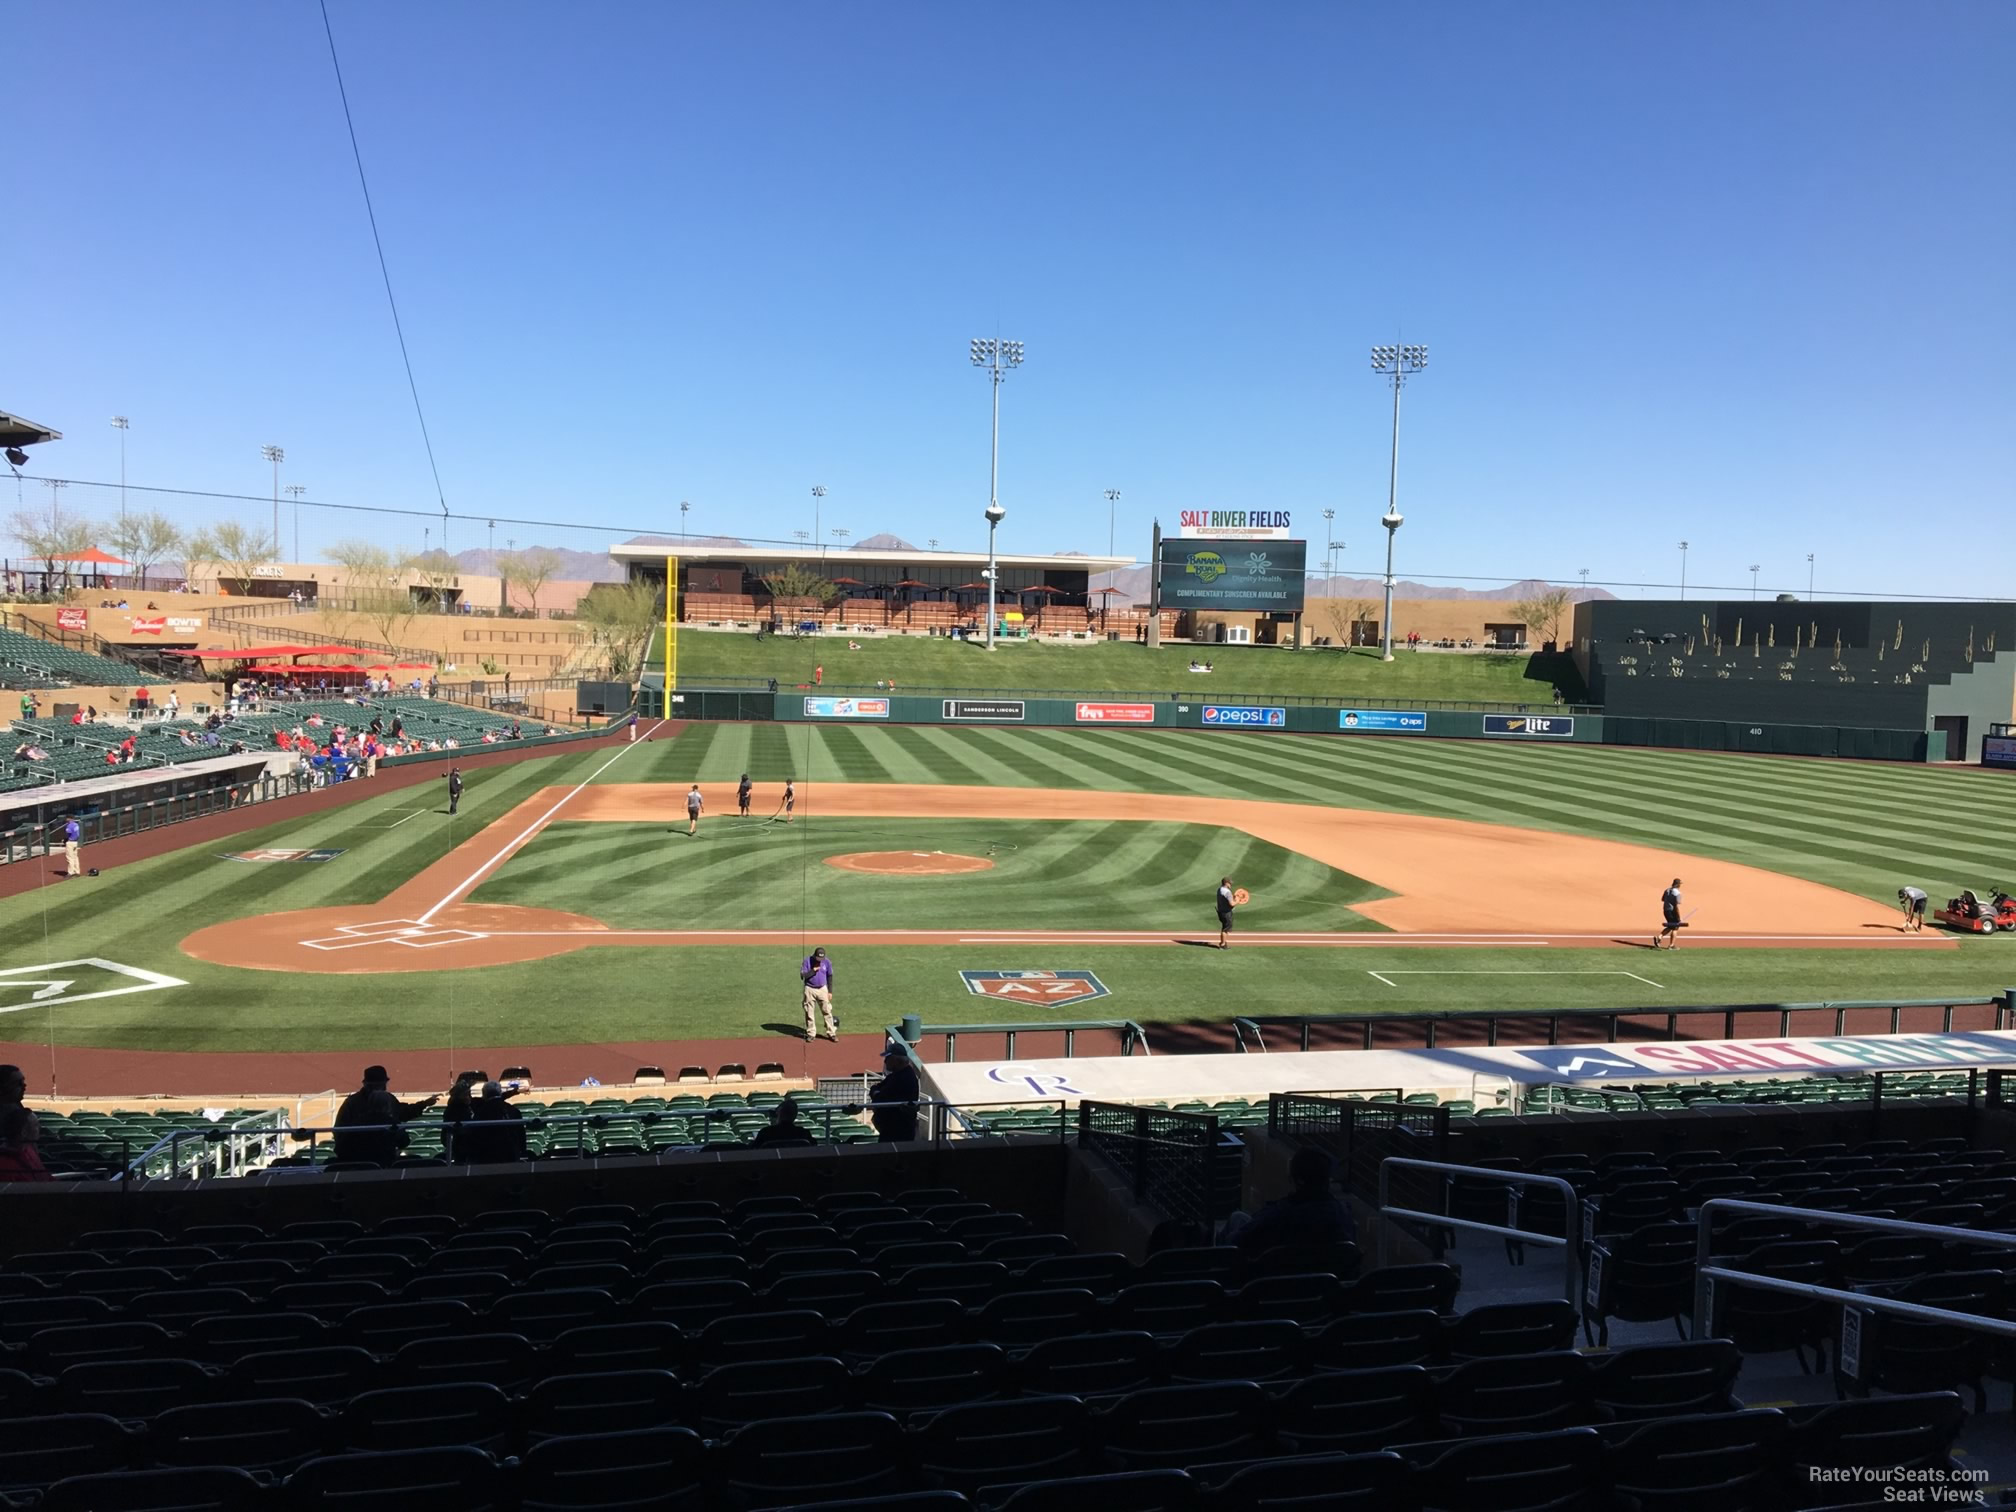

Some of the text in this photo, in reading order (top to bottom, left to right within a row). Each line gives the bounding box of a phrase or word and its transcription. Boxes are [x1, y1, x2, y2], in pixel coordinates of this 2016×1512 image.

[1180, 510, 1290, 528] SALT RIVER FIELDS
[1187, 554, 1223, 565] BANANA
[1232, 575, 1282, 583] Dignity Health
[1176, 589, 1287, 599] COMPLIMENTARY SUNSCREEN AVAILABLE
[1178, 705, 1189, 713] 390
[1220, 709, 1264, 723] pepsi
[1525, 718, 1551, 733] Lite
[1750, 727, 1762, 735] 410
[1635, 1043, 1838, 1071] SALT
